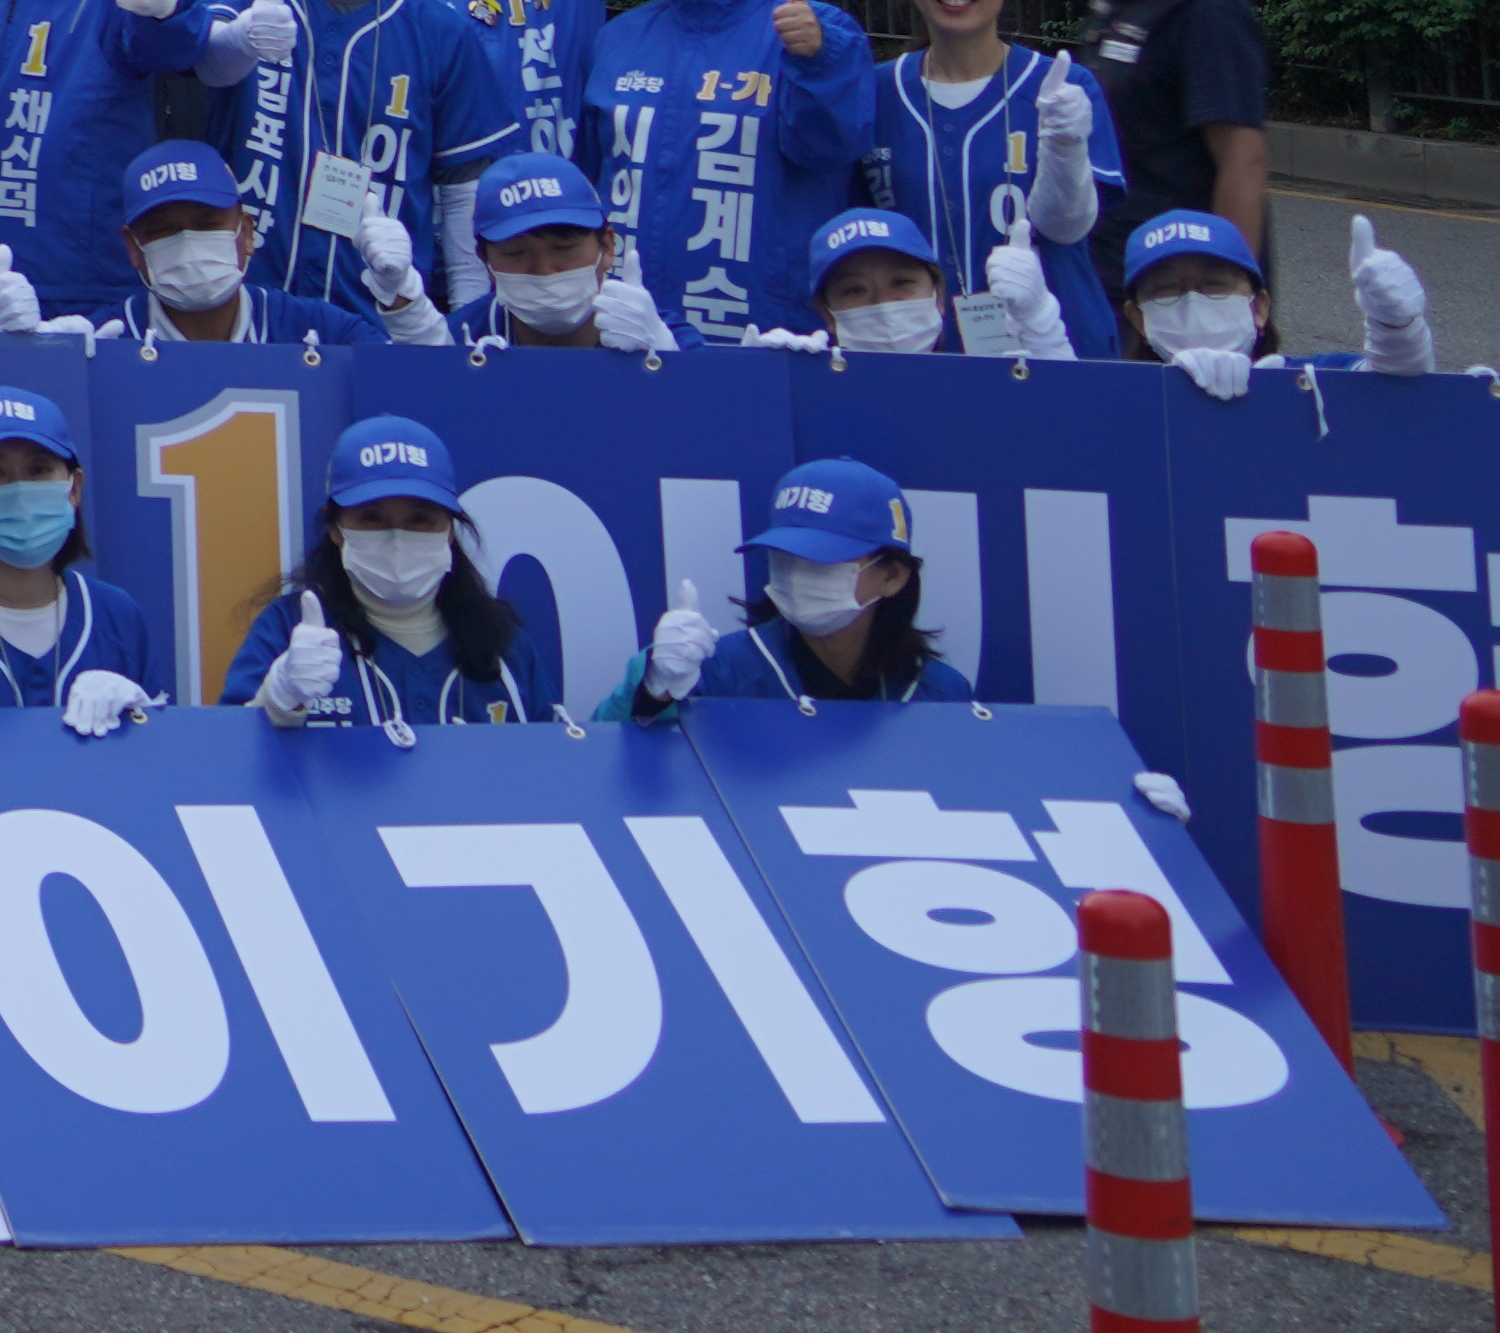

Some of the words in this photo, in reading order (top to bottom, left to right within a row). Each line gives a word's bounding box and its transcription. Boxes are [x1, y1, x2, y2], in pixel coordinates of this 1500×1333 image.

[19, 20, 52, 78] 1
[386, 75, 410, 118] 1
[615, 74, 665, 94] 민주당
[695, 70, 772, 108] 1-가
[1007, 130, 1029, 175] 1
[139, 161, 198, 192] 이기형
[500, 177, 563, 208] 이기형
[682, 111, 763, 346] 김계순
[825, 217, 890, 251] 이기형
[1143, 221, 1213, 249] 이기형
[359, 441, 429, 469] 이기형
[773, 484, 834, 515] 이기형
